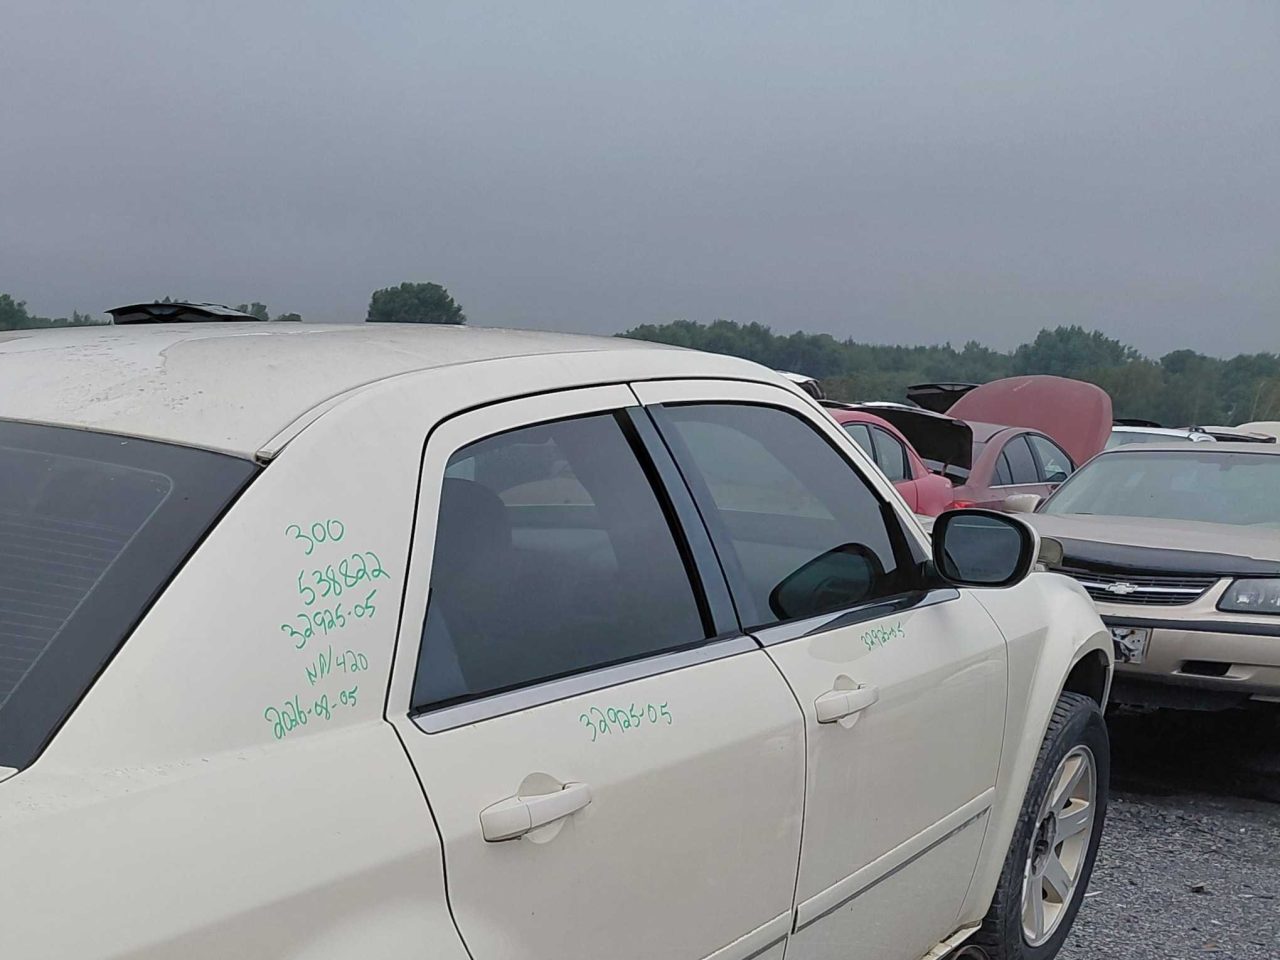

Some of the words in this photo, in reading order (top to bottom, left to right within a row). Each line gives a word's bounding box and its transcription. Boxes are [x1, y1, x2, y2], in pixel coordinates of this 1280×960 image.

[285, 519, 345, 556] 300
[298, 551, 391, 606] 538822
[280, 588, 377, 649] 32925-05
[578, 701, 673, 743] 32925-05
